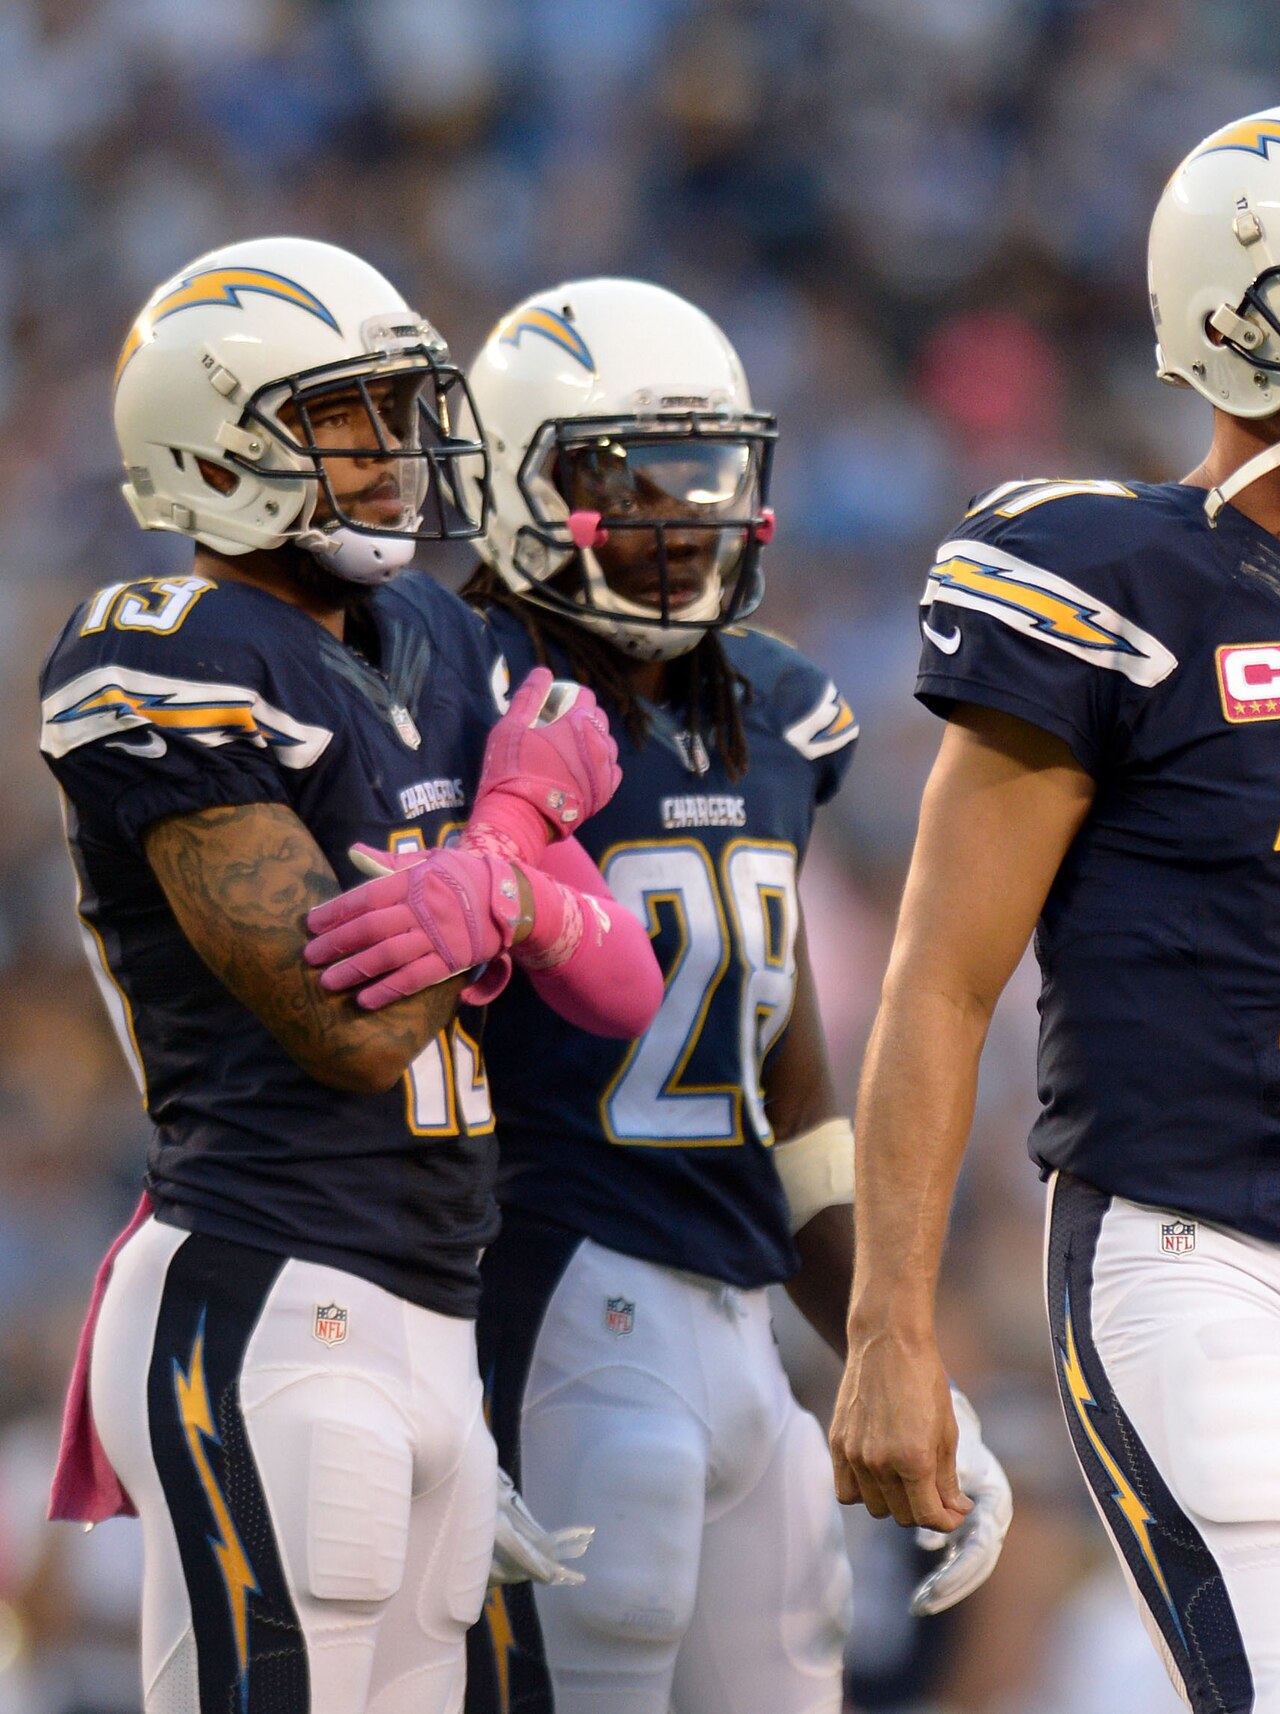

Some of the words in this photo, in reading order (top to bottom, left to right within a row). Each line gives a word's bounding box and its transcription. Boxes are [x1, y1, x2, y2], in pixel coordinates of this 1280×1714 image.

[662, 796, 747, 830] CHARGERS
[1164, 1236, 1193, 1252] NFL
[318, 1320, 345, 1340] NFL
